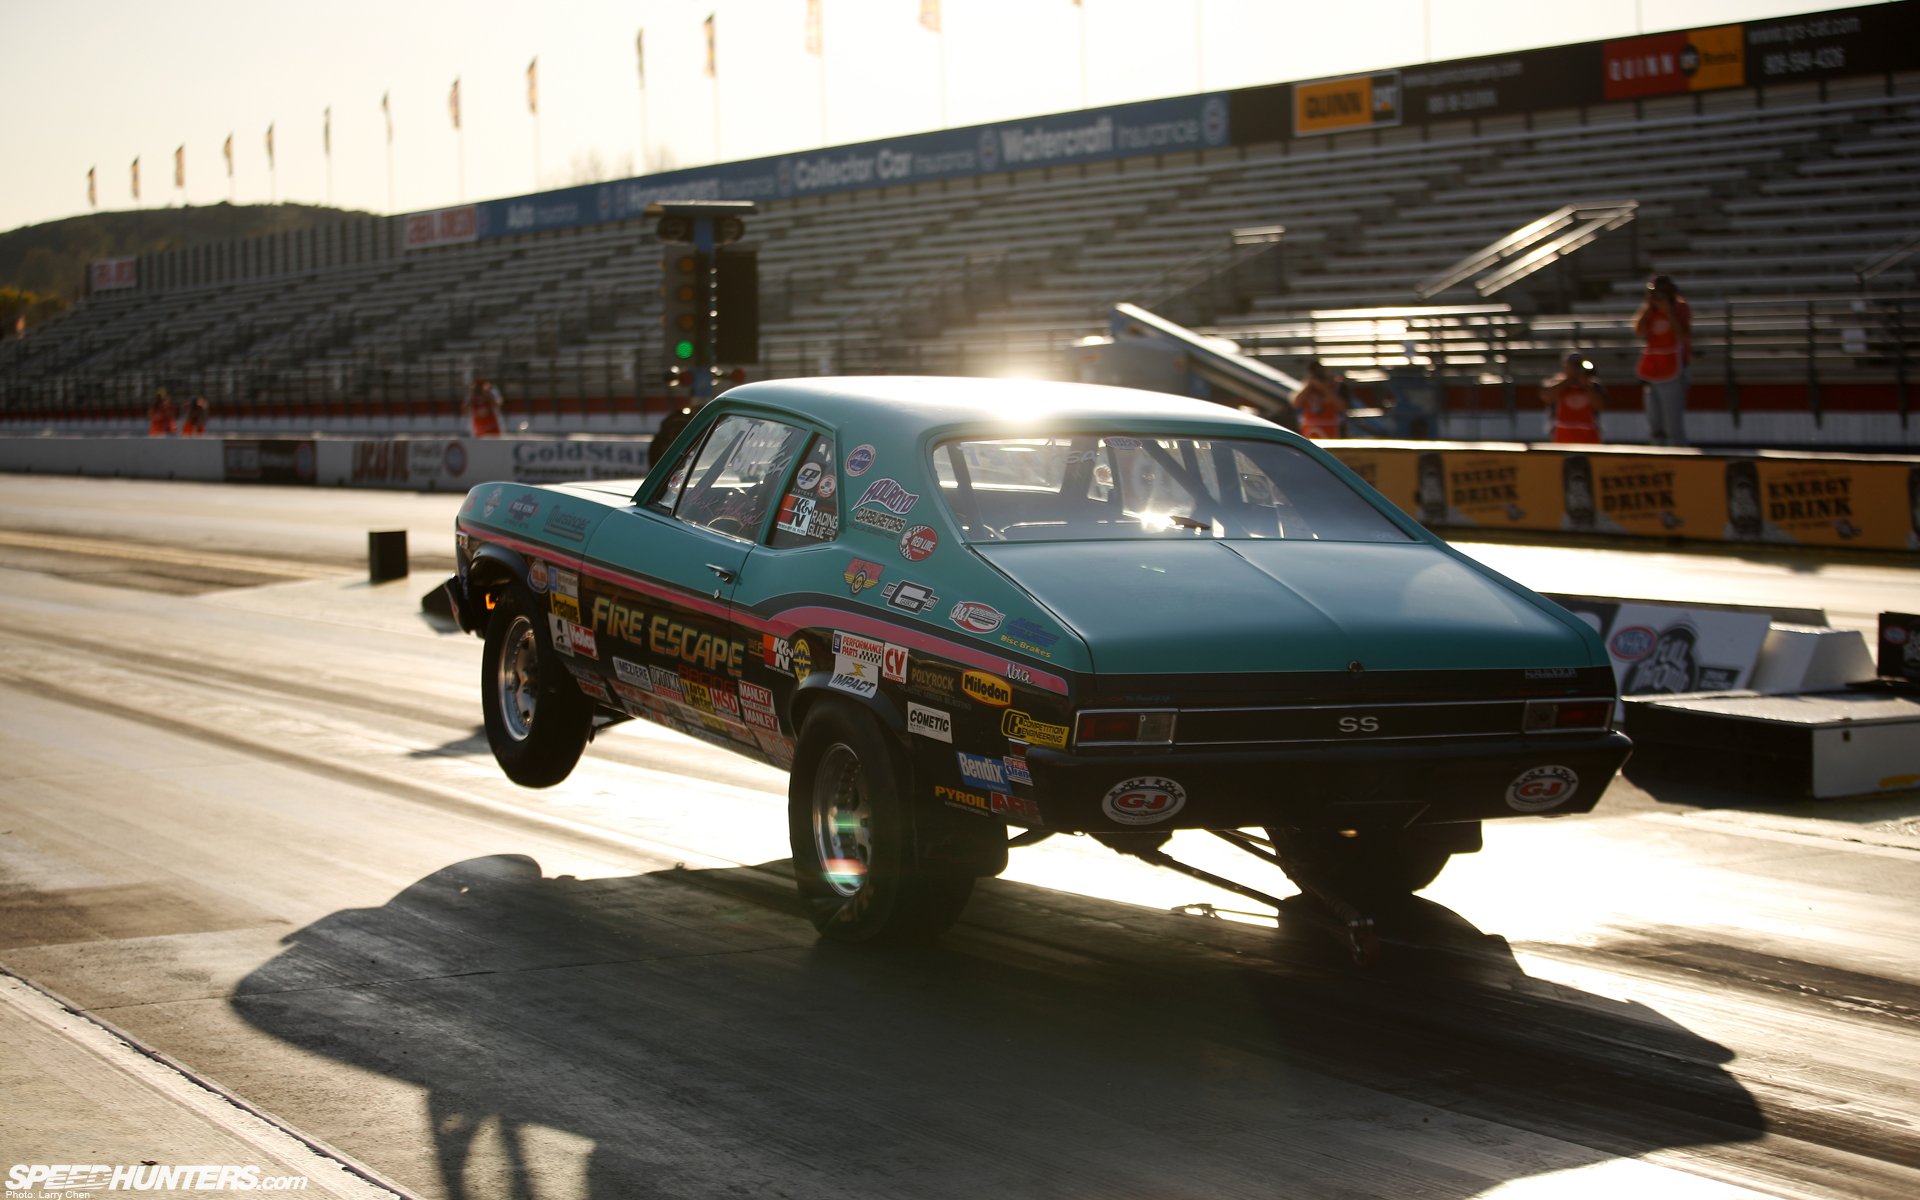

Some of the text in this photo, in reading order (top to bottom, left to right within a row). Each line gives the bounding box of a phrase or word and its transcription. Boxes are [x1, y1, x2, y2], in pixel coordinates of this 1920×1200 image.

[1000, 116, 1113, 162] Watercraft
[794, 156, 876, 190] Collector
[876, 149, 912, 179] Car
[513, 441, 649, 464] GoldStar
[1452, 466, 1518, 484] ENERGY
[1601, 472, 1674, 491] ENERGY
[1453, 484, 1518, 505] DRINK
[1769, 477, 1853, 498] ENERGY
[1603, 491, 1675, 513] DRINK
[1771, 498, 1852, 520] DRINK
[811, 510, 839, 531] RACING
[911, 536, 924, 548] RED
[591, 596, 644, 646] FIRE
[648, 615, 745, 677] ESCAPE
[842, 635, 882, 655] PERFORMANCE
[1000, 634, 1052, 658] Disc Brakes
[842, 645, 859, 659] PARTS
[885, 647, 906, 676] CV
[832, 673, 876, 694] IMPACT
[911, 668, 956, 691] POLYROCK
[964, 675, 1009, 703] Milodon
[711, 687, 739, 714] MSD
[740, 683, 770, 706] MANLEY
[744, 708, 776, 731] MANLEY
[910, 709, 950, 733] COMETIC
[1022, 718, 1066, 736] COMPETITION
[1338, 715, 1381, 734] SS
[1020, 728, 1063, 744] ENGINEERING
[958, 752, 1006, 785] Bendix
[935, 785, 991, 811] PYROIL
